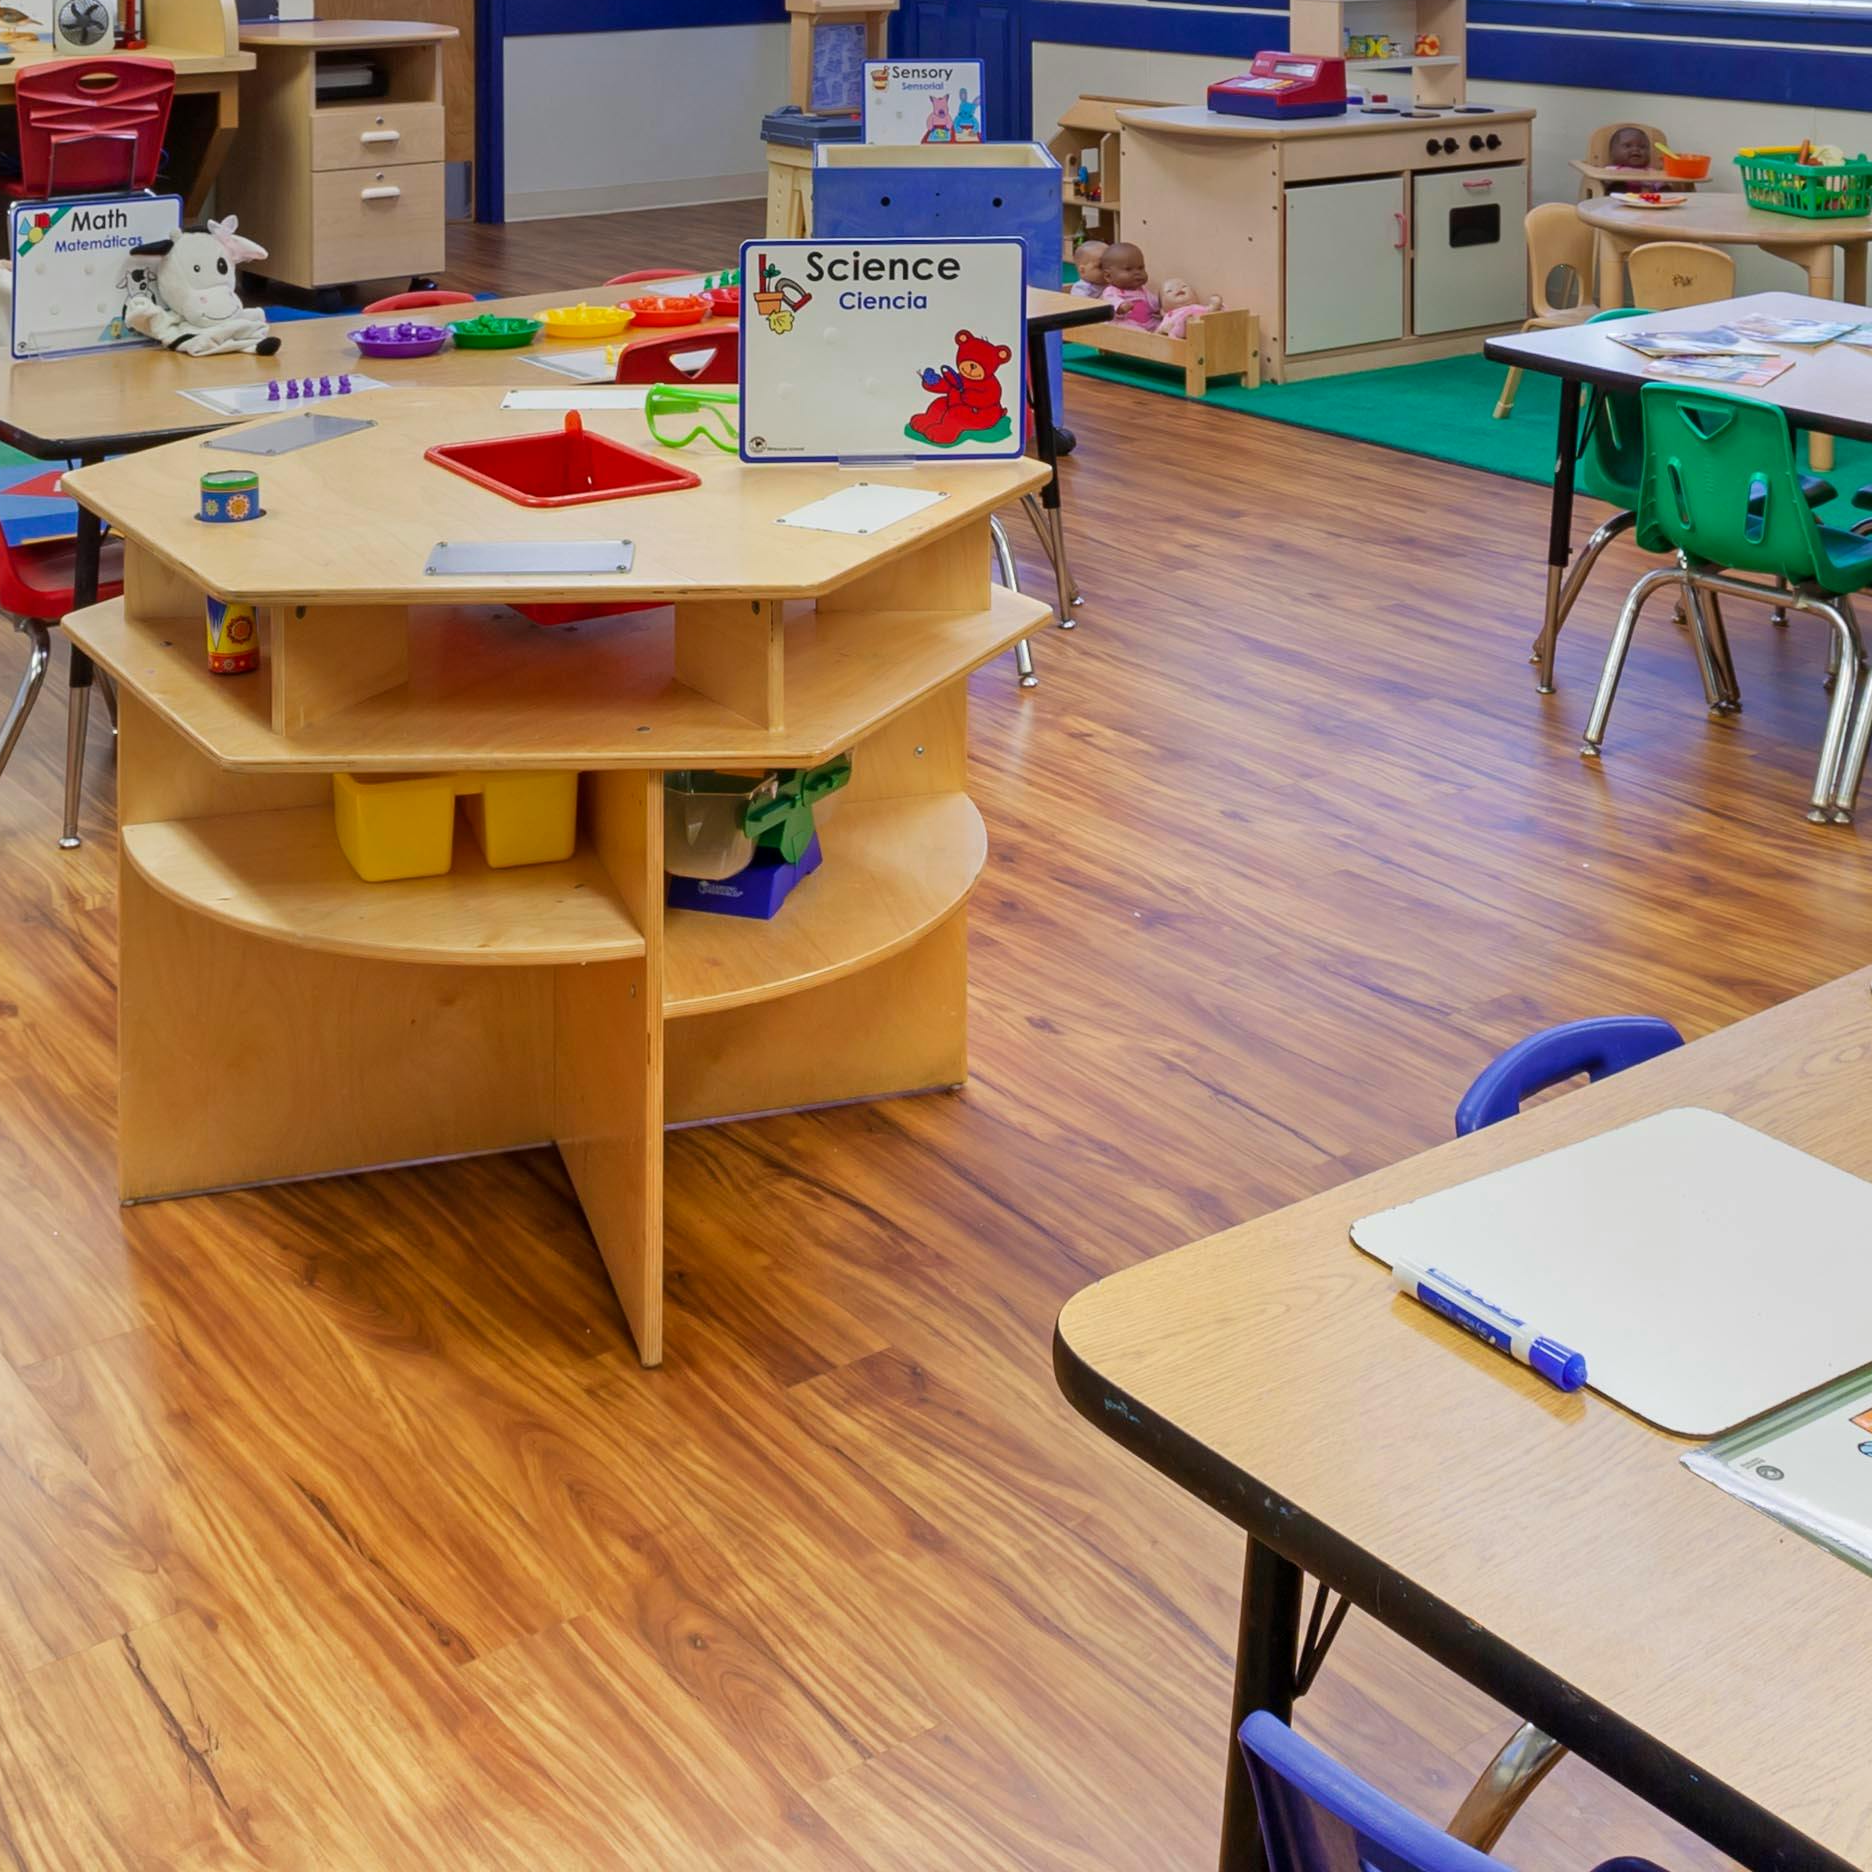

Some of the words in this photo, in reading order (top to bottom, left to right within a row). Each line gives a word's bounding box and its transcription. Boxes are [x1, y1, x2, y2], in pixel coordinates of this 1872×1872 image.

[892, 66, 953, 81] Sensory
[902, 82, 944, 91] Sensorial
[71, 208, 128, 232] Math
[54, 235, 143, 253] Matemáticas
[806, 251, 961, 282] Science
[839, 291, 928, 311] Ciencia
